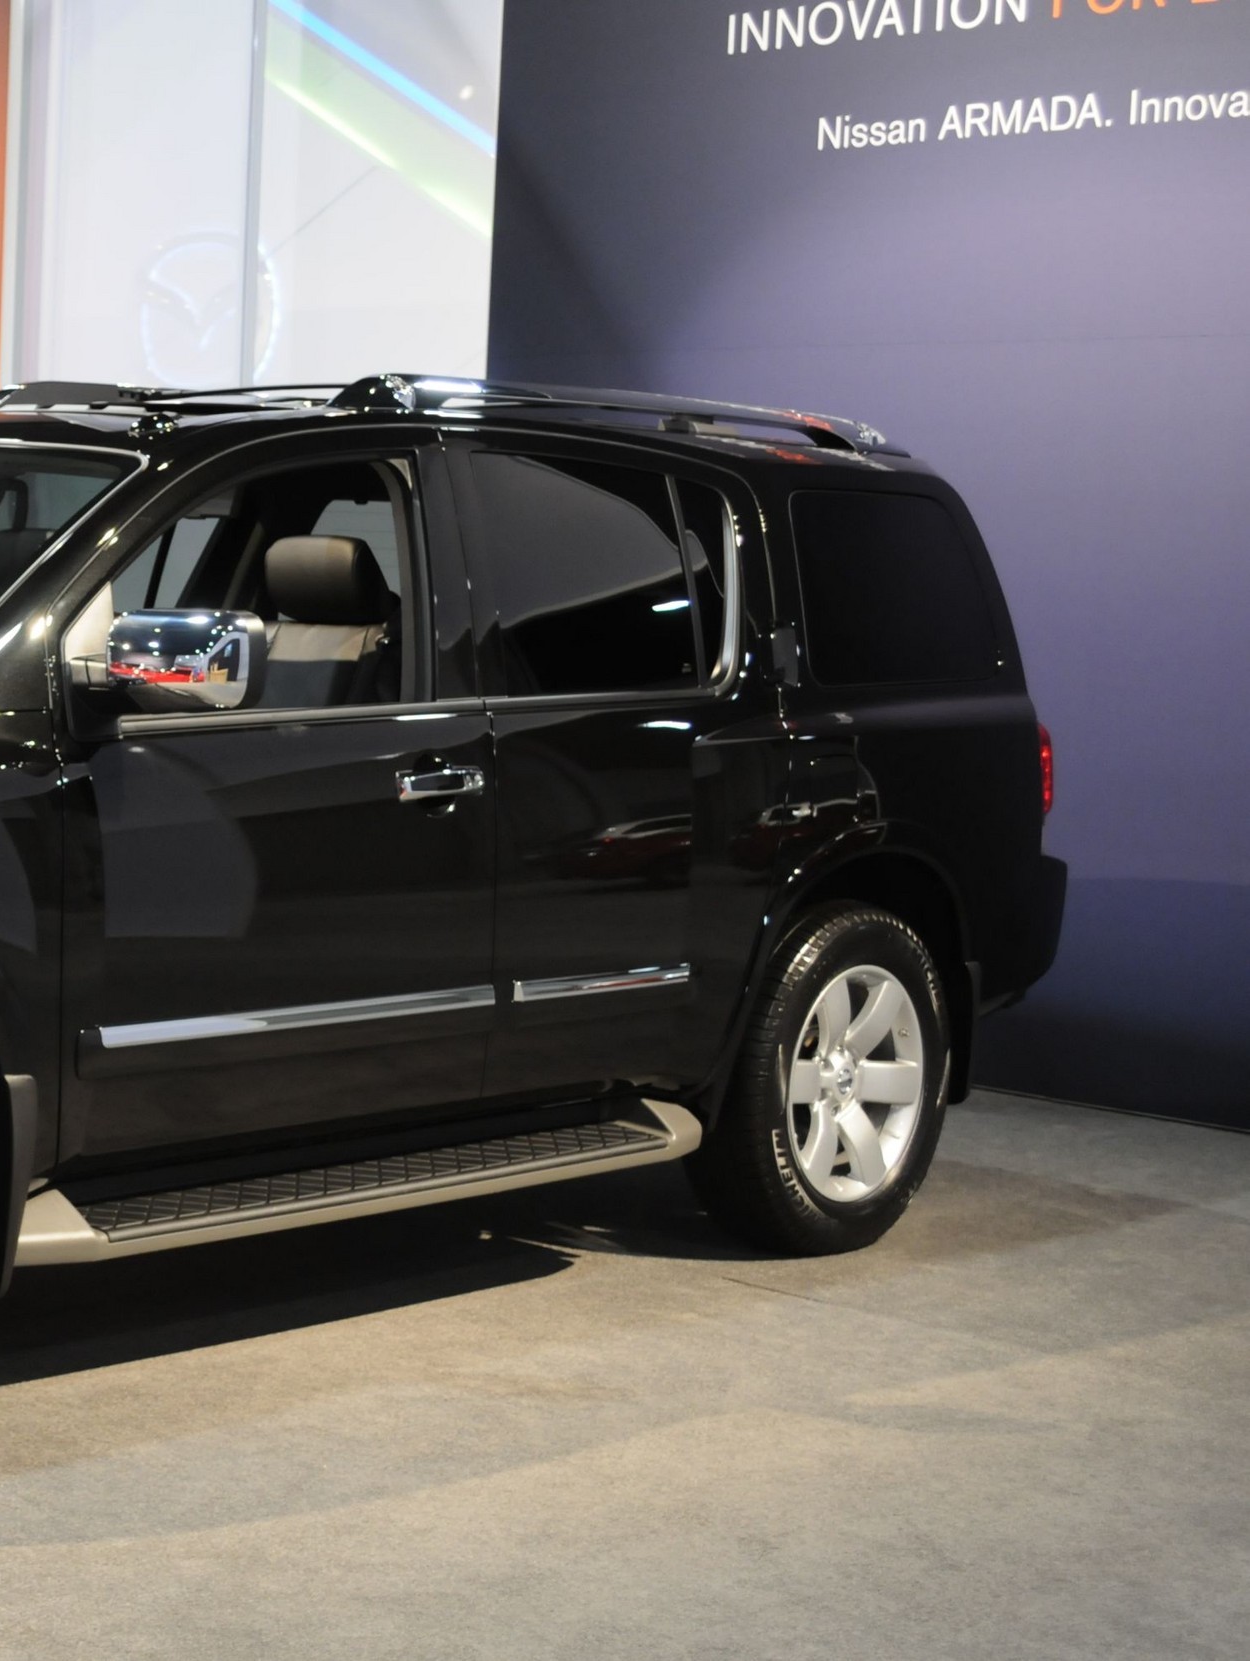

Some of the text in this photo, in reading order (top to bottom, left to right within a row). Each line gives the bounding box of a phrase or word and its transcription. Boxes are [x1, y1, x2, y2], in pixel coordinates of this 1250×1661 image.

[726, 0, 1028, 55] INNOVATION
[817, 114, 926, 151] Nissan
[938, 93, 1113, 141] ARMADA.
